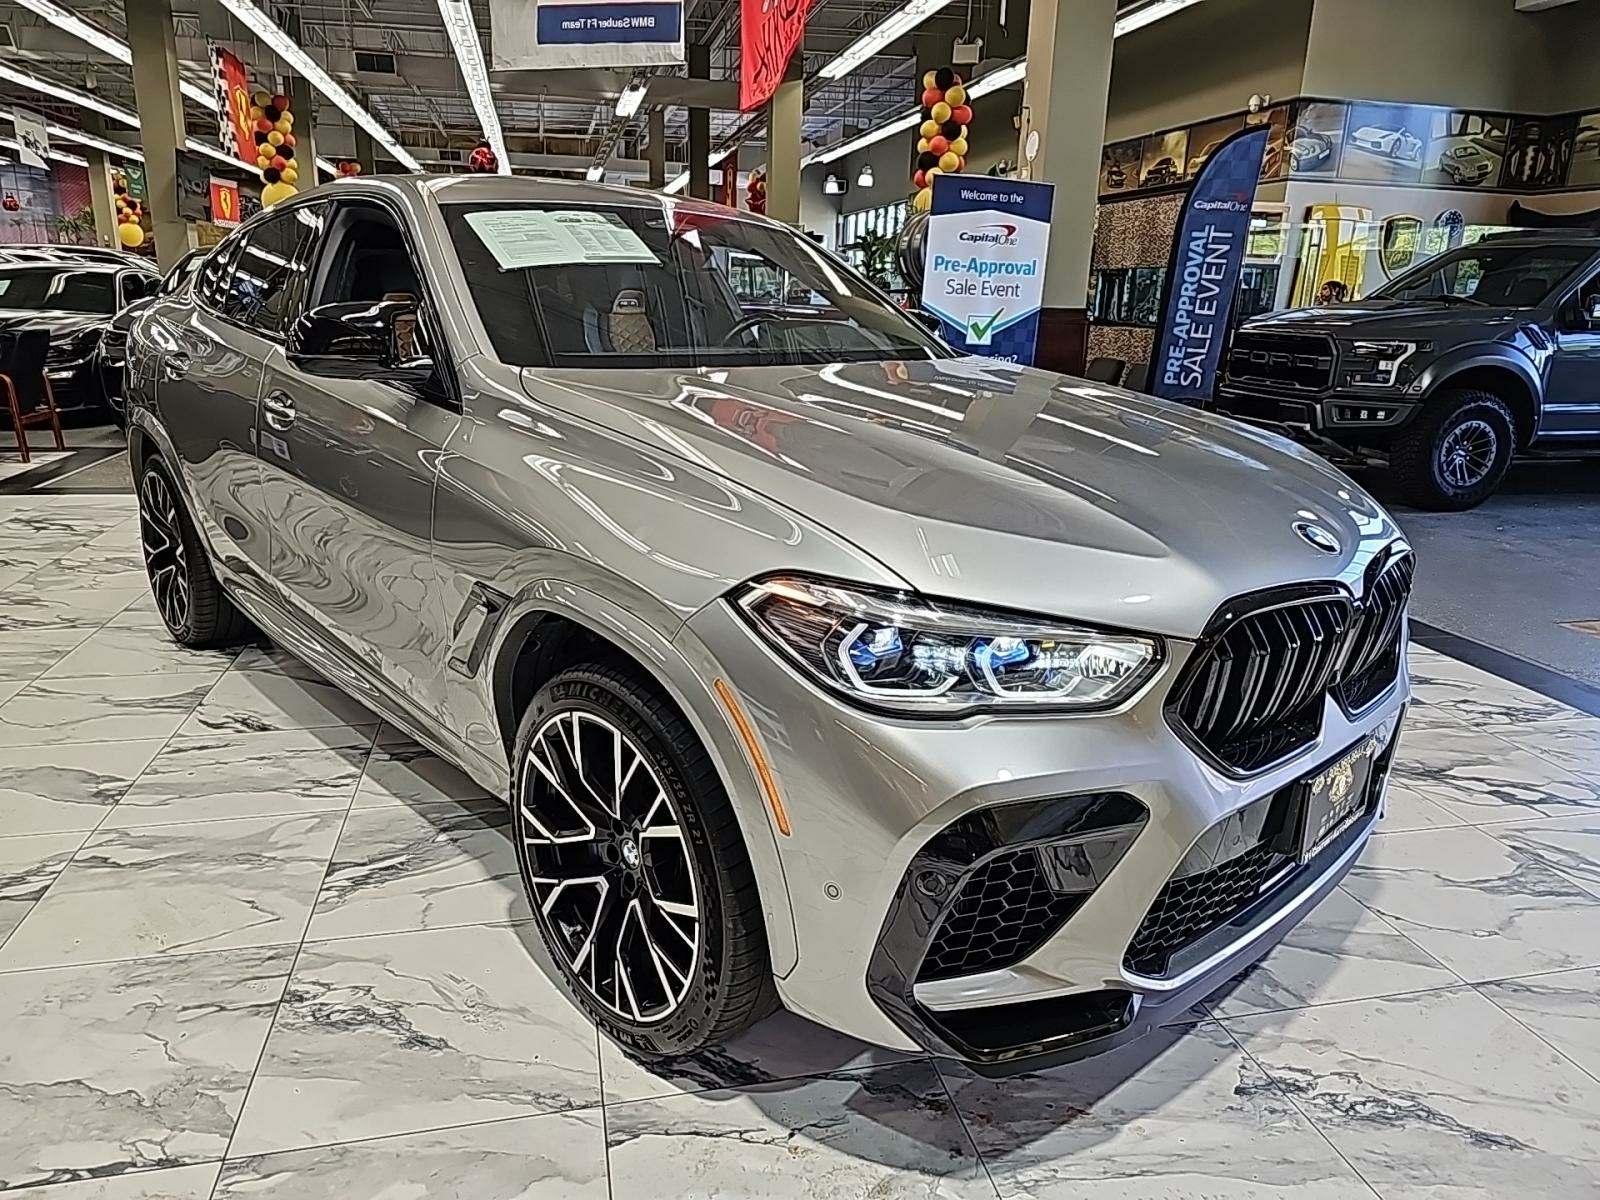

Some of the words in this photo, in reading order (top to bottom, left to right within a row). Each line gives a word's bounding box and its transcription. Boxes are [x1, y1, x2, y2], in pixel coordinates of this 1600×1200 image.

[960, 189, 998, 202] Welcome
[999, 191, 1009, 203] to
[1010, 192, 1024, 204] the
[933, 255, 1037, 278] Pre-Approval
[1195, 224, 1233, 316] EVENT
[945, 279, 977, 296] Sale
[981, 280, 1020, 298] Event
[1163, 224, 1210, 385] PRE-APPROVAL
[1180, 323, 1213, 389] SALE
[1232, 348, 1320, 368] FORD
[569, 682, 654, 742] MICHELIN
